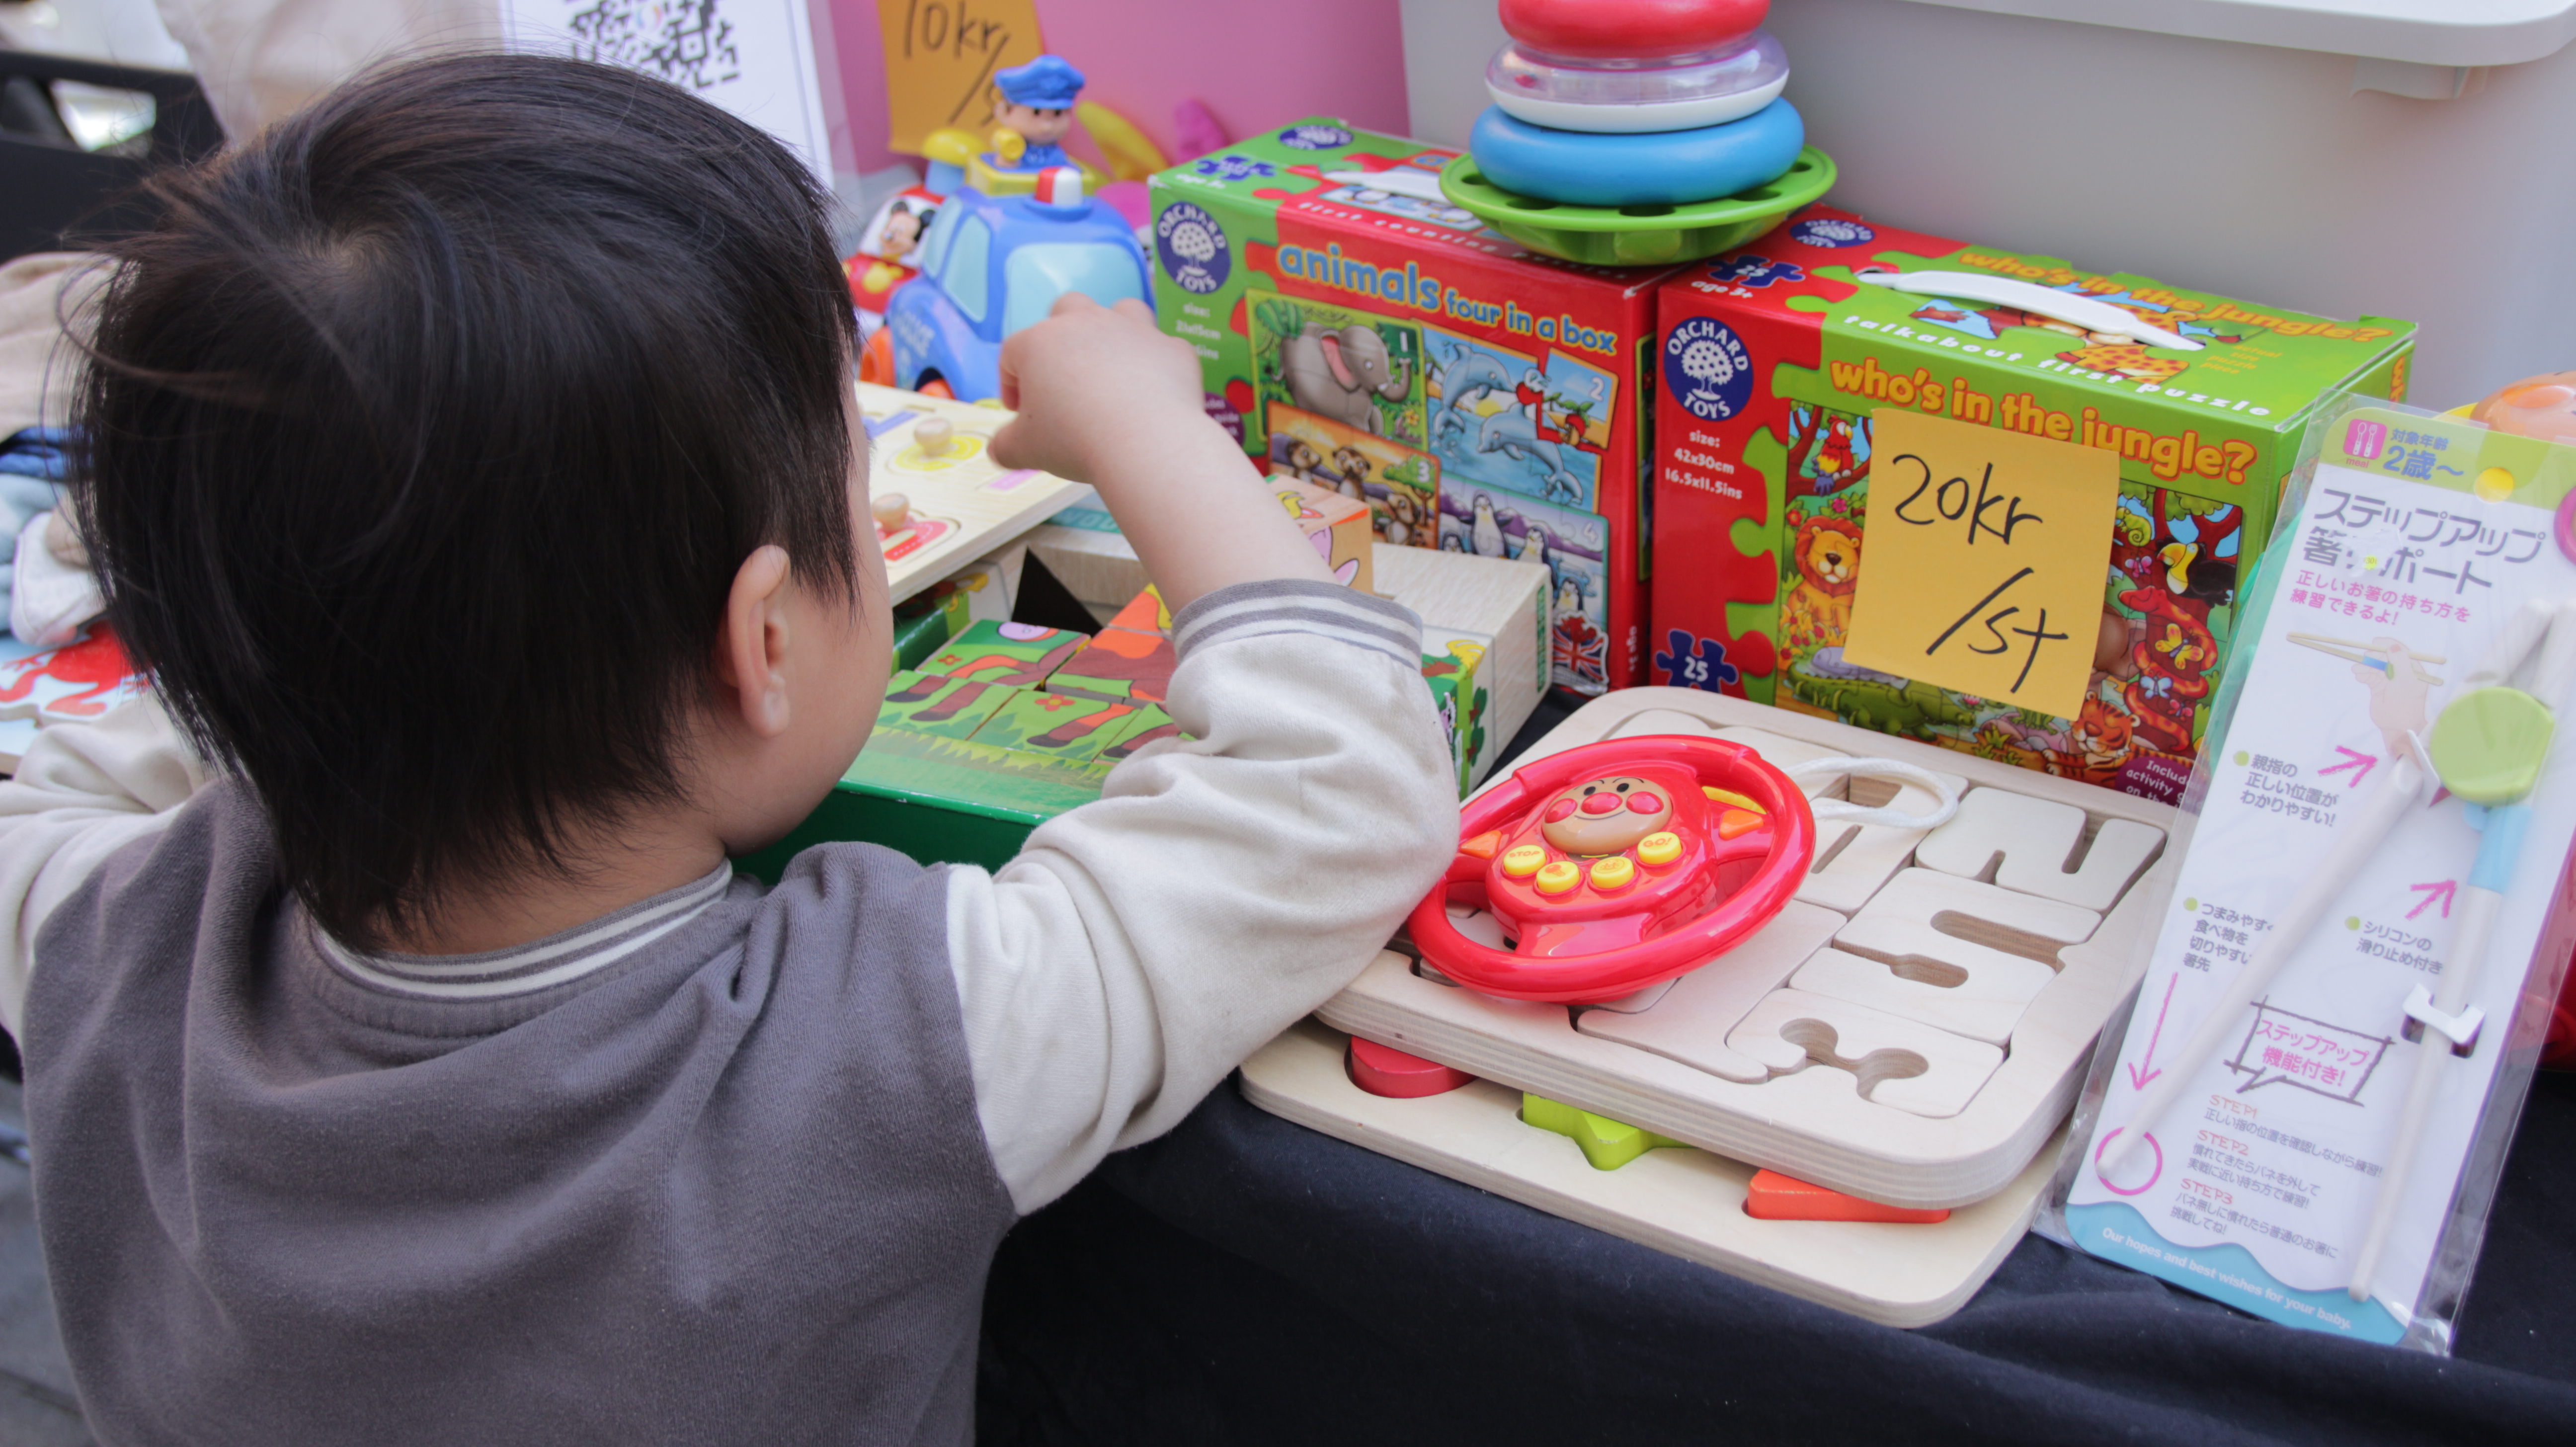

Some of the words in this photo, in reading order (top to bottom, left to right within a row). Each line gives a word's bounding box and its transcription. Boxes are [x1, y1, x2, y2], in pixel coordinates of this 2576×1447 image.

[1157, 203, 1227, 249] ORCHARD
[1176, 270, 1217, 293] TOYS
[1735, 264, 1770, 277] 25
[1278, 242, 1440, 311] animals
[1445, 287, 1502, 325] four
[1506, 301, 1532, 335] in
[1537, 317, 1556, 340] a
[1561, 315, 1617, 355] box
[1691, 281, 1729, 293] age
[1958, 252, 2080, 286] who's
[2077, 276, 2127, 295] in
[2128, 288, 2206, 313] the
[2196, 303, 2394, 342] jungle?
[1667, 321, 1749, 371] ORCHARD
[1843, 315, 2022, 362] talkabout
[2037, 359, 2124, 384] first
[2135, 383, 2270, 416] puzzle
[1590, 376, 1605, 400] 2
[1683, 392, 1731, 419] TOYS
[1831, 356, 1946, 413] who's
[1951, 377, 1994, 425] in
[2000, 393, 2074, 442] the
[2081, 407, 2257, 485] jungle?
[1689, 430, 1720, 448] size:
[2390, 428, 2449, 451] 対象年齢
[1417, 460, 1431, 483] 3
[1674, 448, 1735, 475] 42x30cm
[2345, 458, 2370, 468] meal
[1665, 468, 1743, 500] 16.5x11.5ins
[1892, 454, 2043, 545] 20kr
[2313, 487, 2546, 563] ステップアップ
[2290, 588, 2399, 626] 練習できるよ!
[2295, 569, 2471, 623] 正しいお箸の持ち方を
[1683, 656, 1709, 681] 25
[2251, 754, 2298, 778] 親指の
[2126, 769, 2174, 796] activity
[2126, 785, 2141, 796] on
[2147, 792, 2168, 805] th
[2245, 771, 2339, 807] 正しい位置が
[2240, 790, 2336, 827] わかりやすい!
[1642, 837, 1673, 848] GO!
[2194, 919, 2249, 946] 食べ物を
[2363, 921, 2432, 951] シリコンの
[2183, 952, 2211, 972] 箸先
[2356, 937, 2443, 975] 滑り止め付き
[2256, 1019, 2370, 1066] ステップアップ
[2262, 1045, 2346, 1086] 機能付き!
[2197, 1129, 2249, 1156] STEP2
[2180, 1178, 2234, 1205] STEP3
[2102, 1227, 2124, 1244] Our
[2125, 1235, 2162, 1259] hopes
[2163, 1251, 2187, 1268] and
[2188, 1259, 2217, 1279] best
[2218, 1271, 2262, 1296] wishes
[2265, 1287, 2284, 1303] for
[2283, 1297, 2316, 1317] your
[2316, 1307, 2352, 1330] baby.
